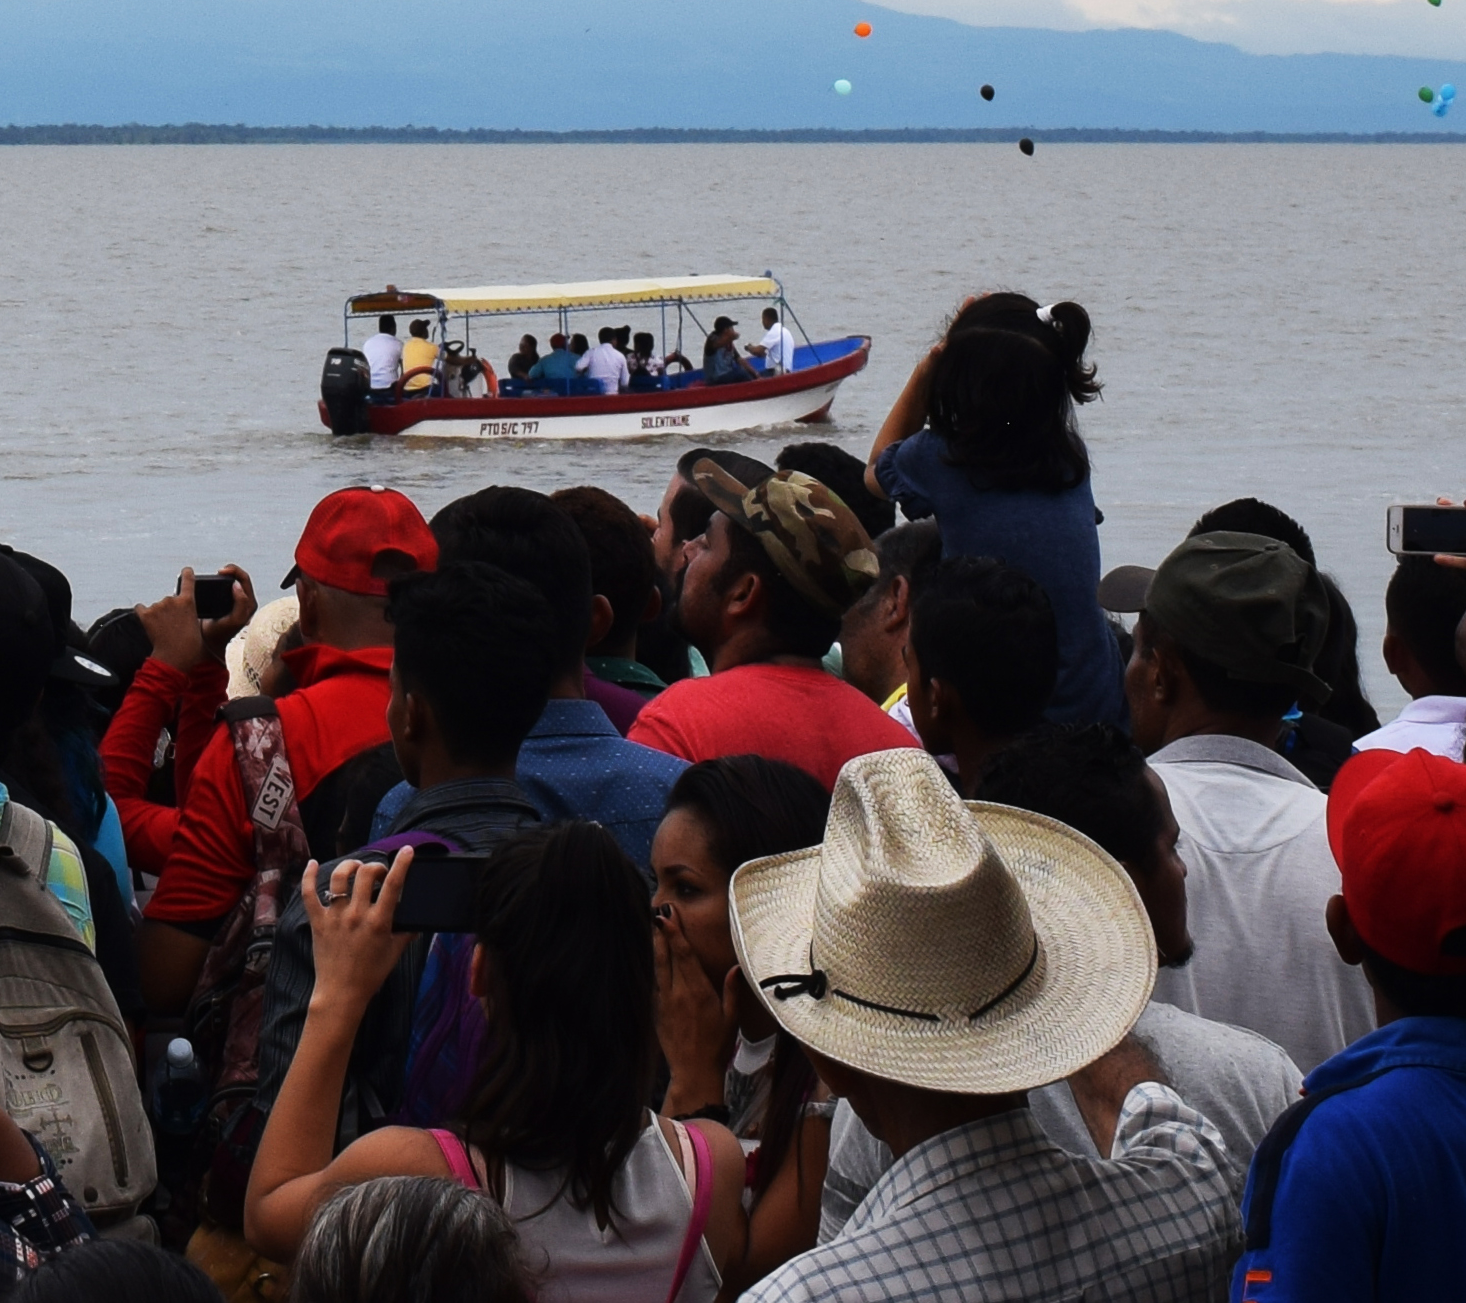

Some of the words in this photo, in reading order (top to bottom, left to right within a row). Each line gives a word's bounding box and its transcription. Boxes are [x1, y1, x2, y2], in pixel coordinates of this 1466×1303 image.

[480, 422, 499, 436] PTO
[521, 421, 540, 434] 797
[259, 766, 292, 821] WEST
